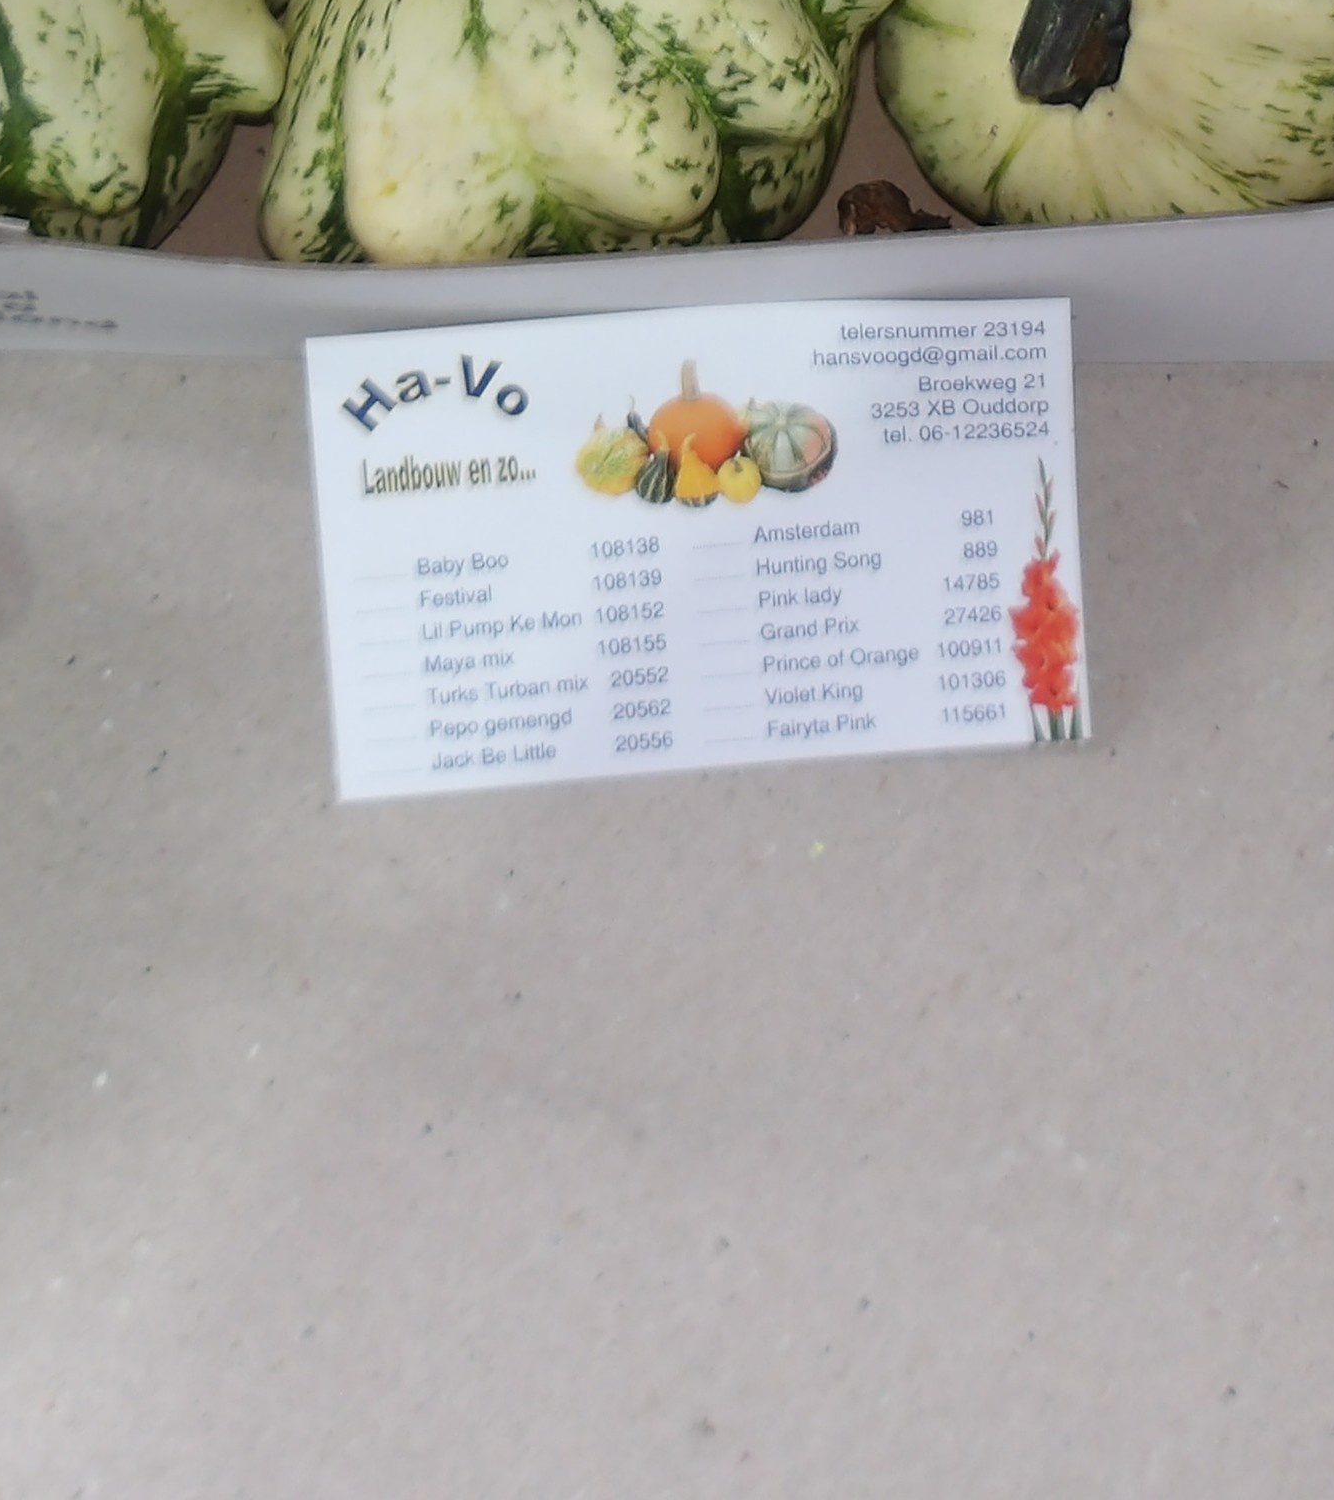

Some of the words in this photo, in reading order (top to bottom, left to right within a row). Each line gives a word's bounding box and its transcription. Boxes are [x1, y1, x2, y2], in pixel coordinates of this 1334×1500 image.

[841, 323, 976, 340] telersnummer
[984, 321, 1045, 337] 23194
[813, 346, 1046, 367] hansvoogd@gmail.com
[342, 354, 529, 432] Ha-Vo
[919, 376, 1016, 392] Broekweg
[1024, 374, 1045, 389] 21
[871, 403, 920, 418] 3253
[928, 400, 955, 416] XB
[963, 398, 1048, 416] Ouddorp
[884, 426, 911, 443] tel.
[919, 422, 1049, 441] 06-12236524
[363, 456, 461, 494] Landbouw
[469, 458, 491, 482] en
[499, 455, 536, 481] zo...
[754, 520, 859, 543] Amsterdam
[961, 510, 993, 526] 981
[417, 558, 465, 578] Baby
[472, 553, 509, 570] Boo
[591, 536, 659, 558] 108138
[757, 555, 827, 575] Hunting
[834, 551, 881, 570] Song
[963, 541, 997, 558] 889
[420, 585, 492, 607] Festival
[593, 569, 662, 590] 108139
[759, 589, 799, 608] Pink
[805, 586, 842, 606] lady
[943, 573, 999, 592] 14785
[423, 623, 443, 640] Lil
[450, 619, 503, 638] Pump
[511, 614, 535, 632] Ke
[543, 612, 582, 628] Mon
[595, 602, 664, 624] 108152
[761, 620, 817, 640] Grand
[825, 618, 859, 635] Prix
[945, 606, 1001, 624] 27426
[425, 655, 475, 674] Maya
[483, 650, 514, 667] mix
[598, 634, 667, 656] 108155
[763, 654, 821, 672] Prince
[827, 650, 844, 667] of
[851, 646, 919, 666] Orange
[938, 638, 1001, 658] 100911
[427, 684, 479, 704] Turks
[485, 680, 550, 700] Turban
[557, 675, 589, 692] mix
[611, 666, 669, 688] 20552
[765, 686, 816, 705] Violet
[823, 682, 863, 701] King
[939, 670, 1006, 690] 101306
[431, 719, 479, 739] Pepo
[485, 709, 572, 736] gemengd
[613, 700, 671, 720] 20562
[837, 713, 877, 731] Pink
[943, 704, 1006, 722] 115661
[433, 752, 473, 770] Jack
[482, 748, 507, 765] Be
[514, 743, 557, 762] Little
[616, 732, 673, 752] 20556
